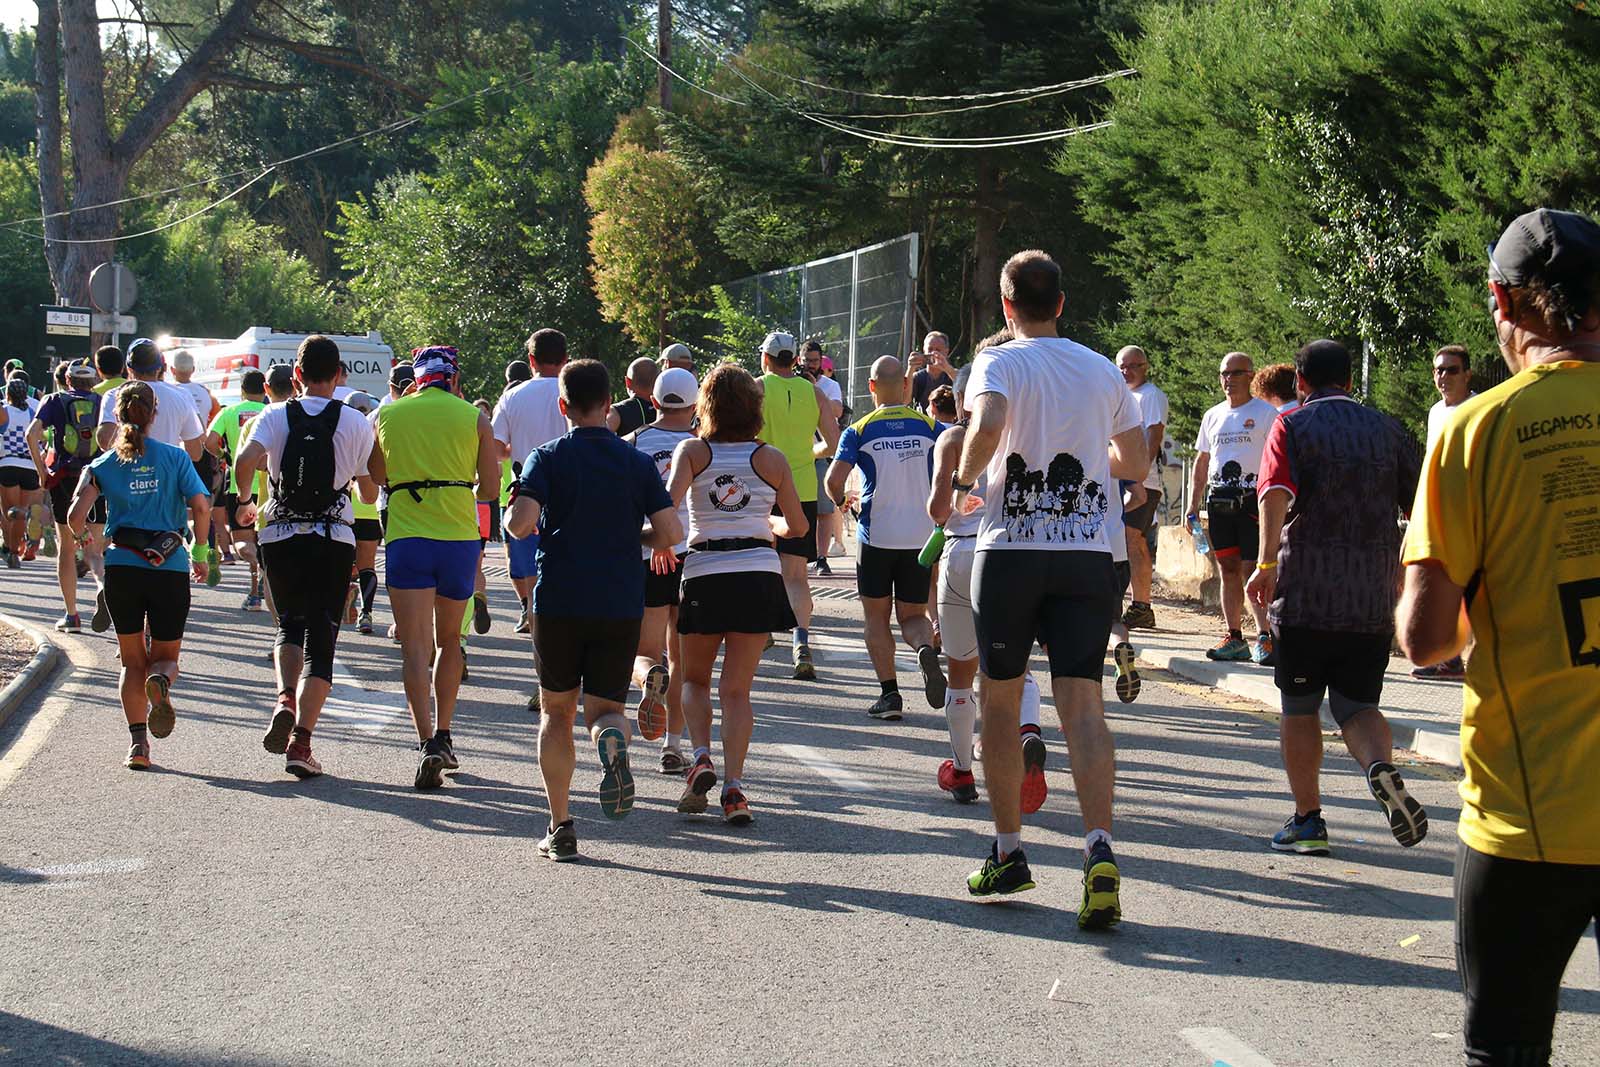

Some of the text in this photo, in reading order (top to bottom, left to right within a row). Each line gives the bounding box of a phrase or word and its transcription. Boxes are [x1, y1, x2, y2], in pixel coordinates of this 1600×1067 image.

[67, 313, 86, 323] BUS
[1516, 413, 1594, 444] LLEGAMOS
[129, 479, 160, 490] claror
